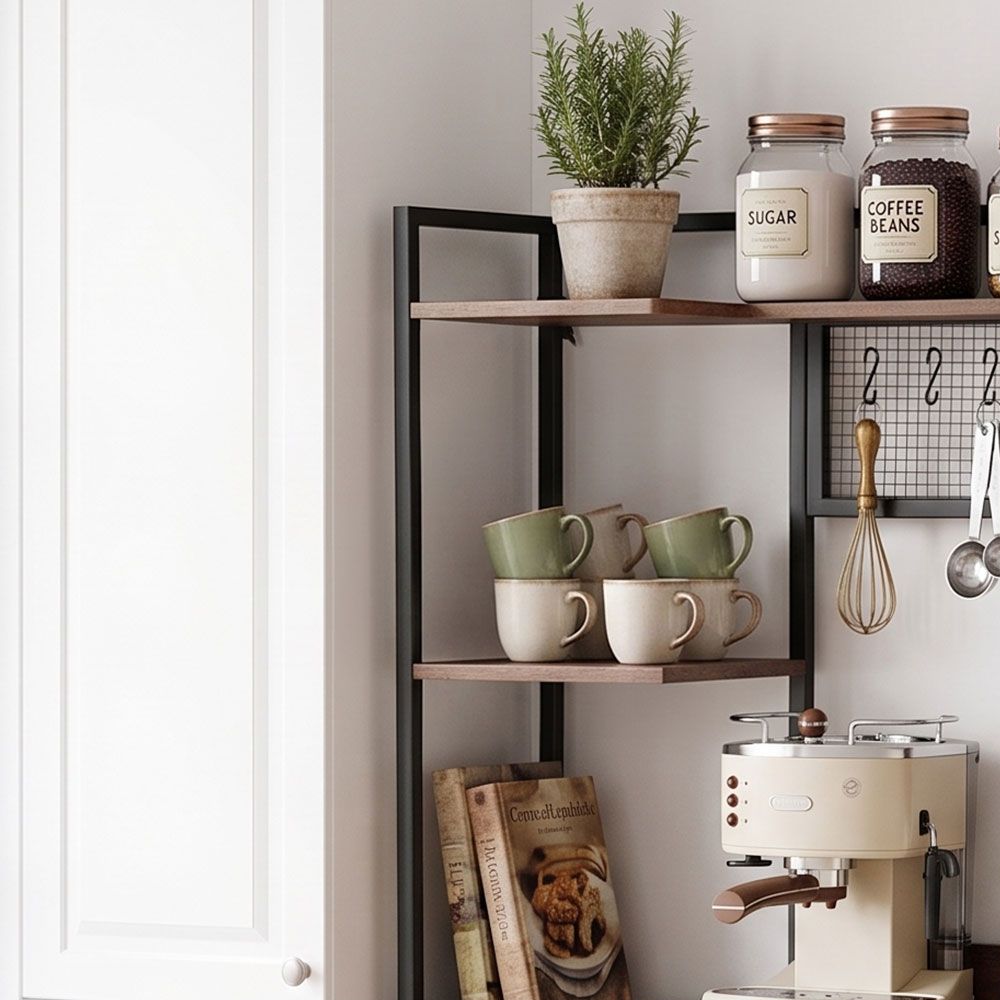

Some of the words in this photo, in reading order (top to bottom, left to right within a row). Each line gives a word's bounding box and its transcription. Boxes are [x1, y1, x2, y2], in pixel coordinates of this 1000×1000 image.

[868, 200, 924, 216] COFFEE
[748, 209, 797, 226] SUGAR
[870, 217, 920, 234] BEANS
